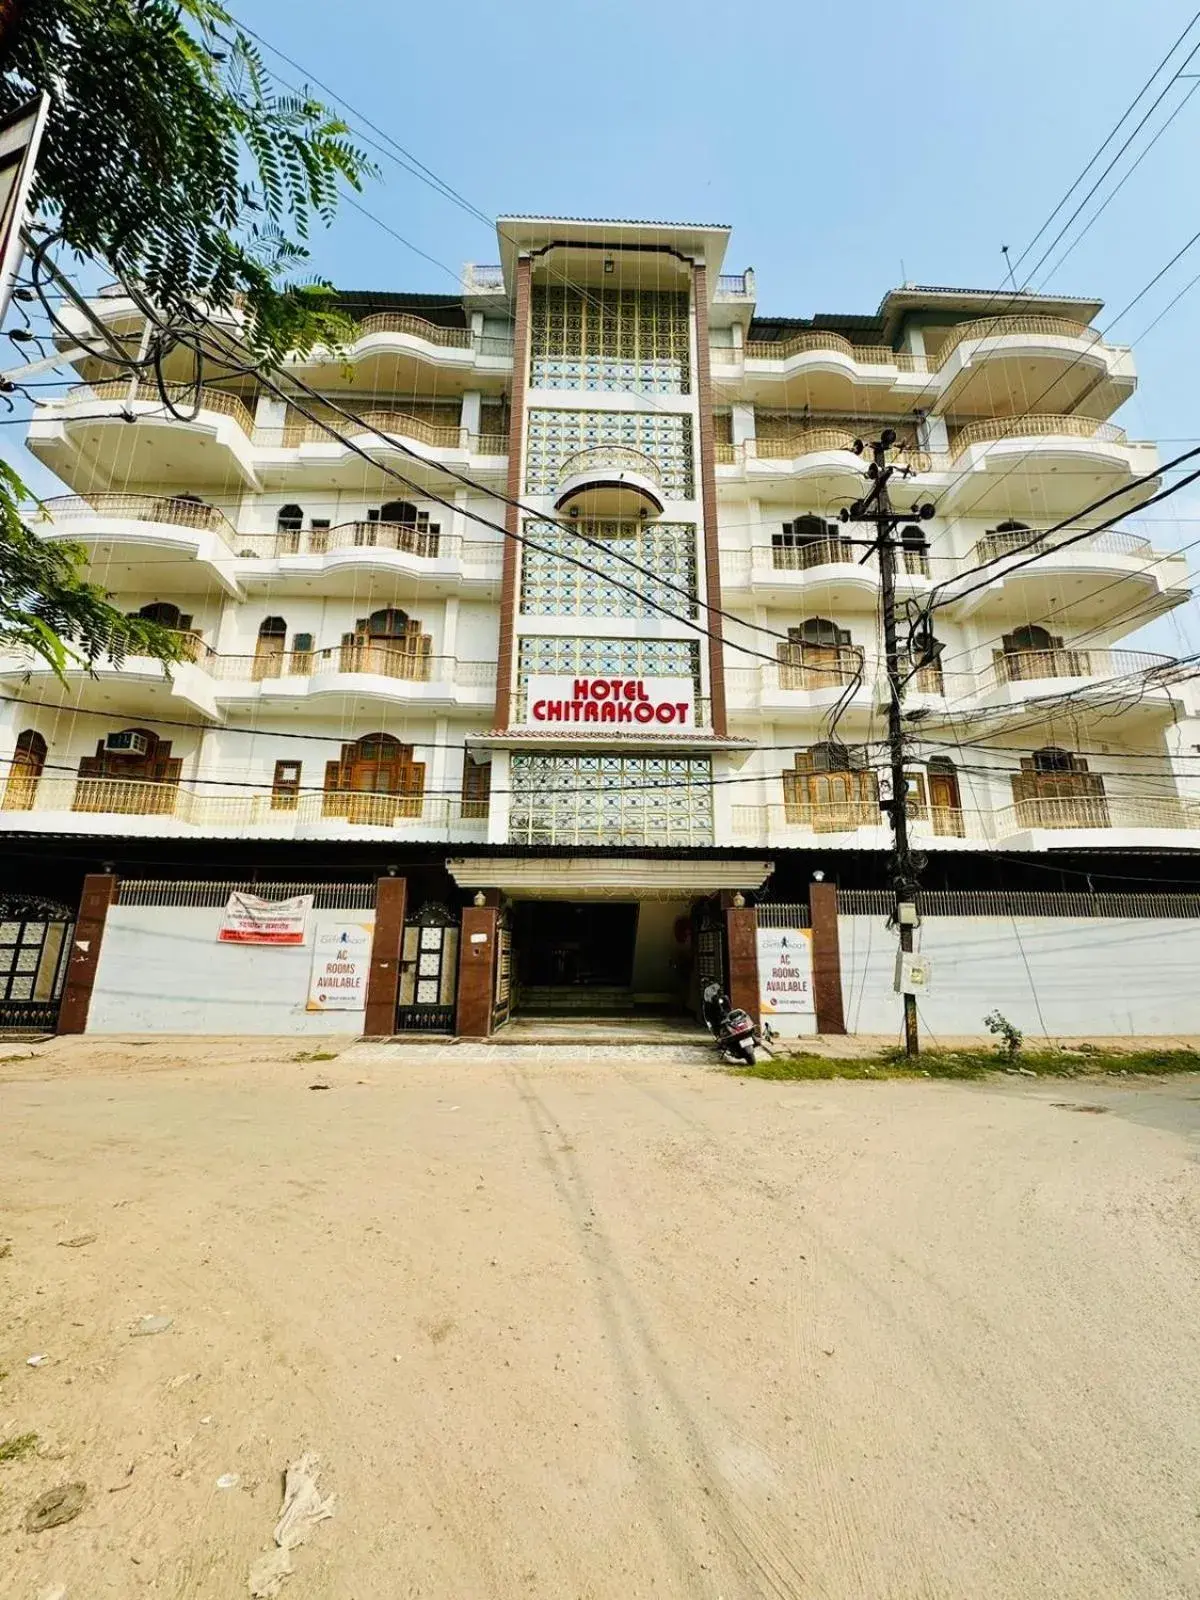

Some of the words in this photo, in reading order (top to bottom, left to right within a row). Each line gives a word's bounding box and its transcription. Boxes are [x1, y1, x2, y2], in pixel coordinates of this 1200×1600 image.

[573, 679, 649, 701] HOTEL
[532, 700, 689, 724] CHITRAKOOT
[336, 950, 348, 961] AC
[780, 954, 791, 965] AC
[326, 963, 356, 975] ROOMS
[772, 967, 800, 979] ROOMS
[317, 976, 362, 989] AVAILABLE
[766, 980, 808, 992] AVAILABLE
